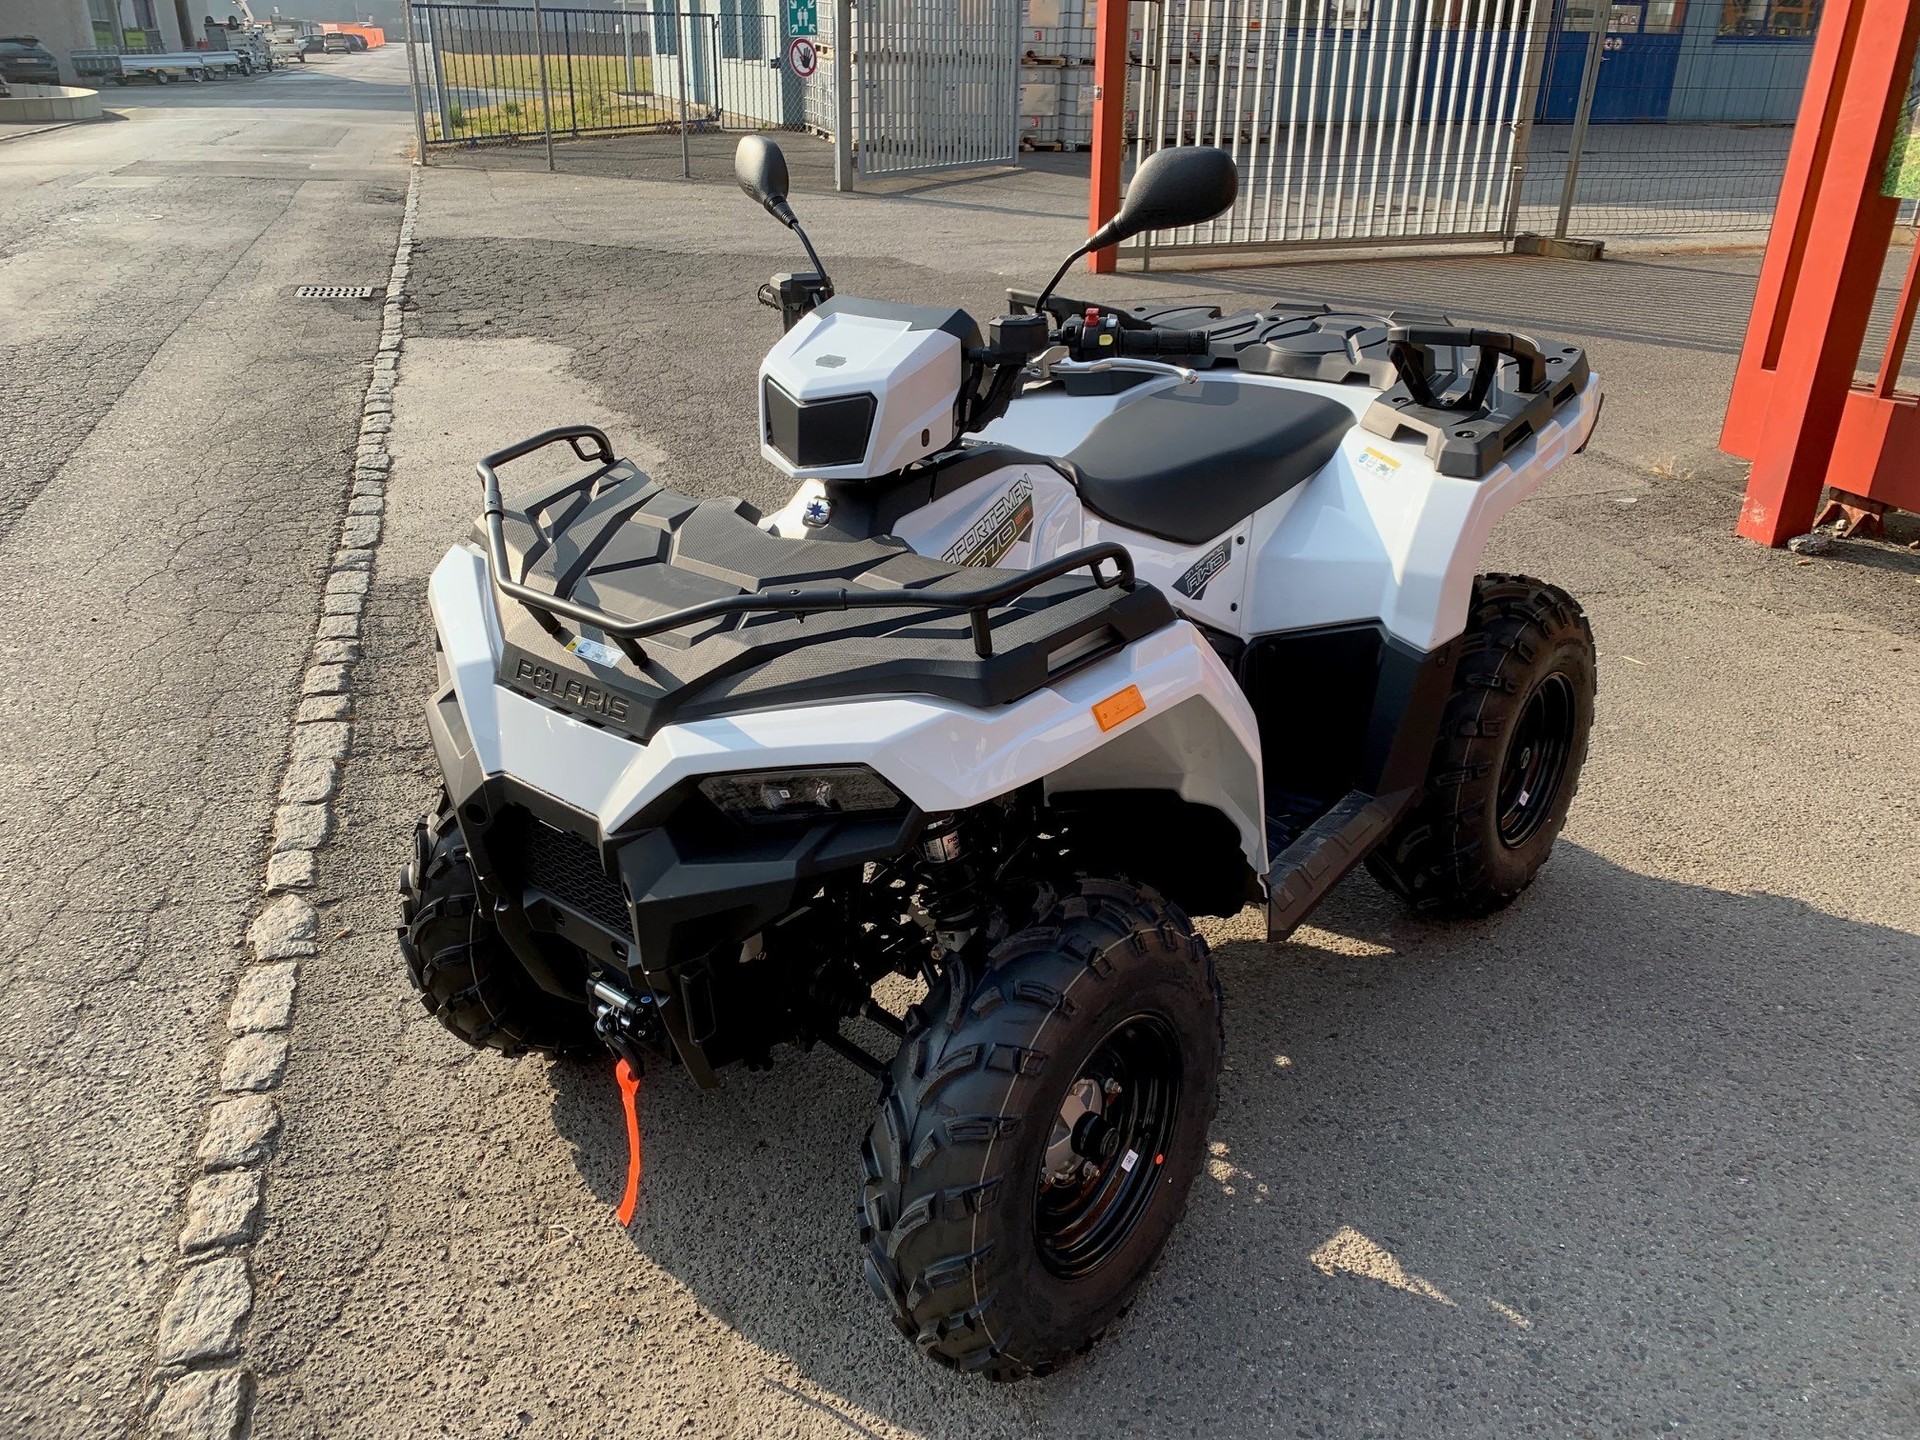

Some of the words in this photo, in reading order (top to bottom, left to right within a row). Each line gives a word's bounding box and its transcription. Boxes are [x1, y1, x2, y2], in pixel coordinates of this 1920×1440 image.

[941, 472, 1034, 566] SPORTSMAN
[1186, 551, 1226, 594] AWD
[516, 658, 629, 723] POLARIS
